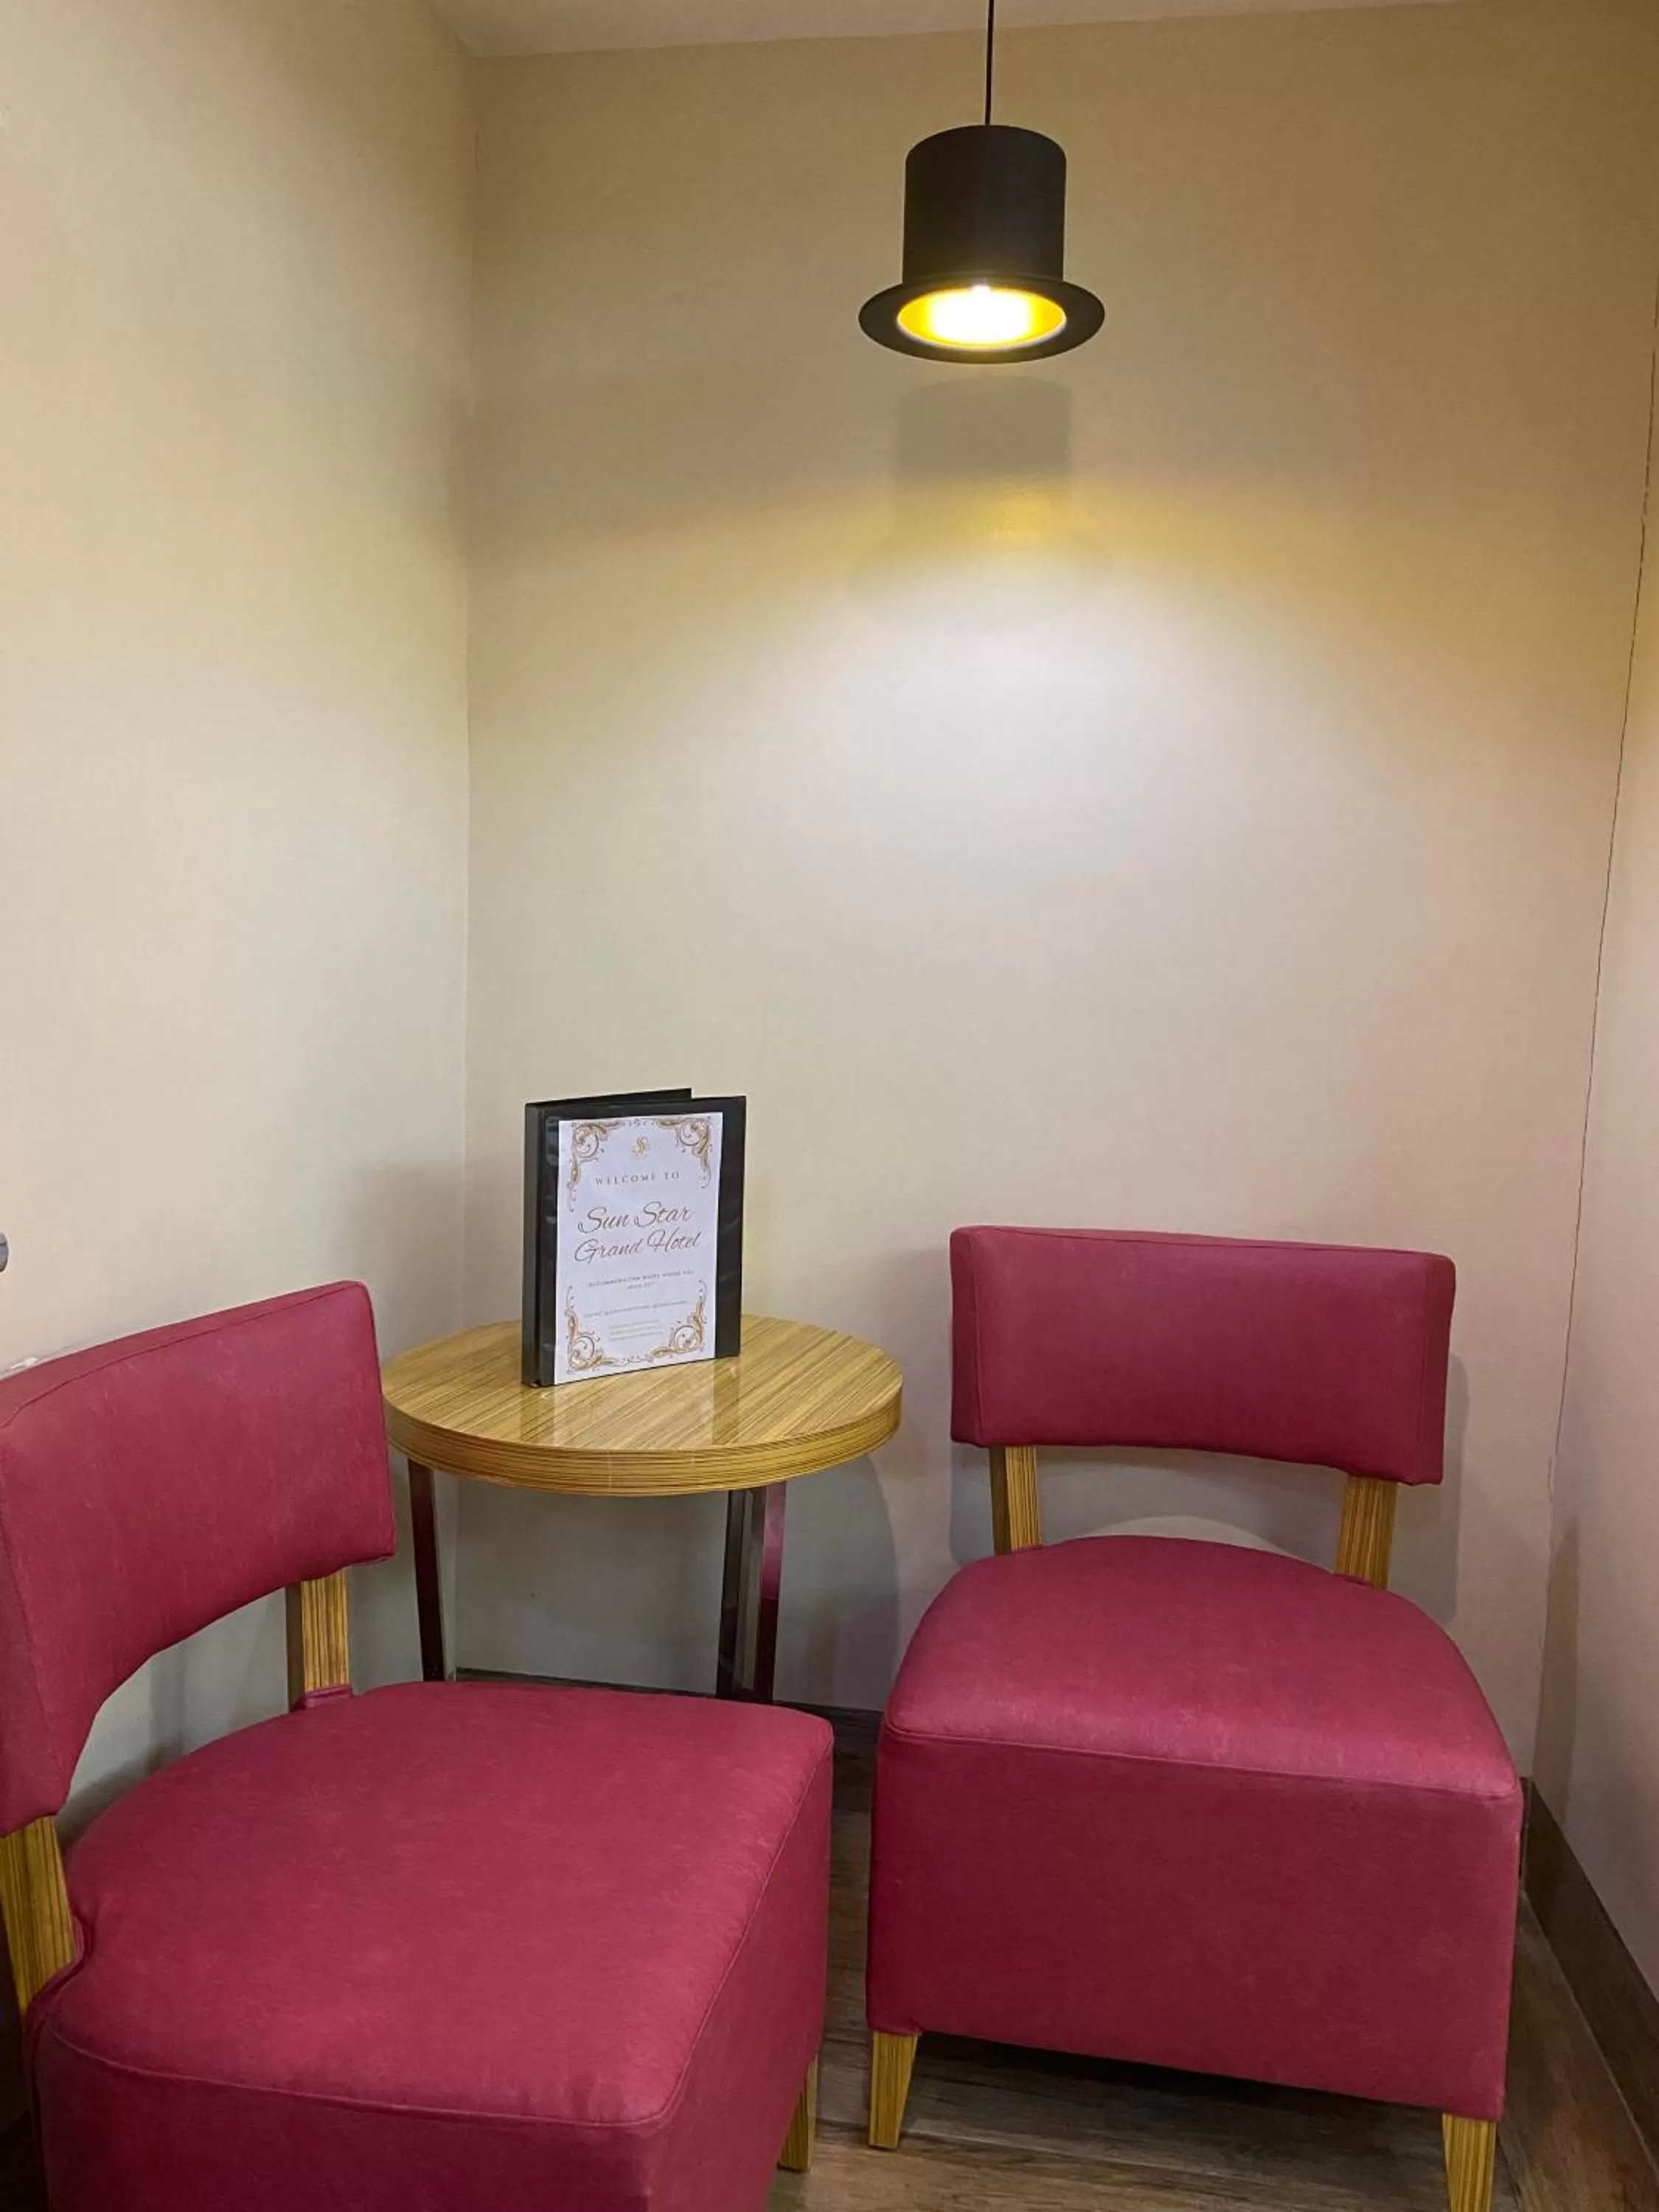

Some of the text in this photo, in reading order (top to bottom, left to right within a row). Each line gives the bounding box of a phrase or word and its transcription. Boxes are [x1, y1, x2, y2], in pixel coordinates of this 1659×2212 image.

[595, 1171, 680, 1186] WELCOME TO
[577, 1201, 692, 1234] Sun Star
[574, 1226, 702, 1264] Grand Hotel
